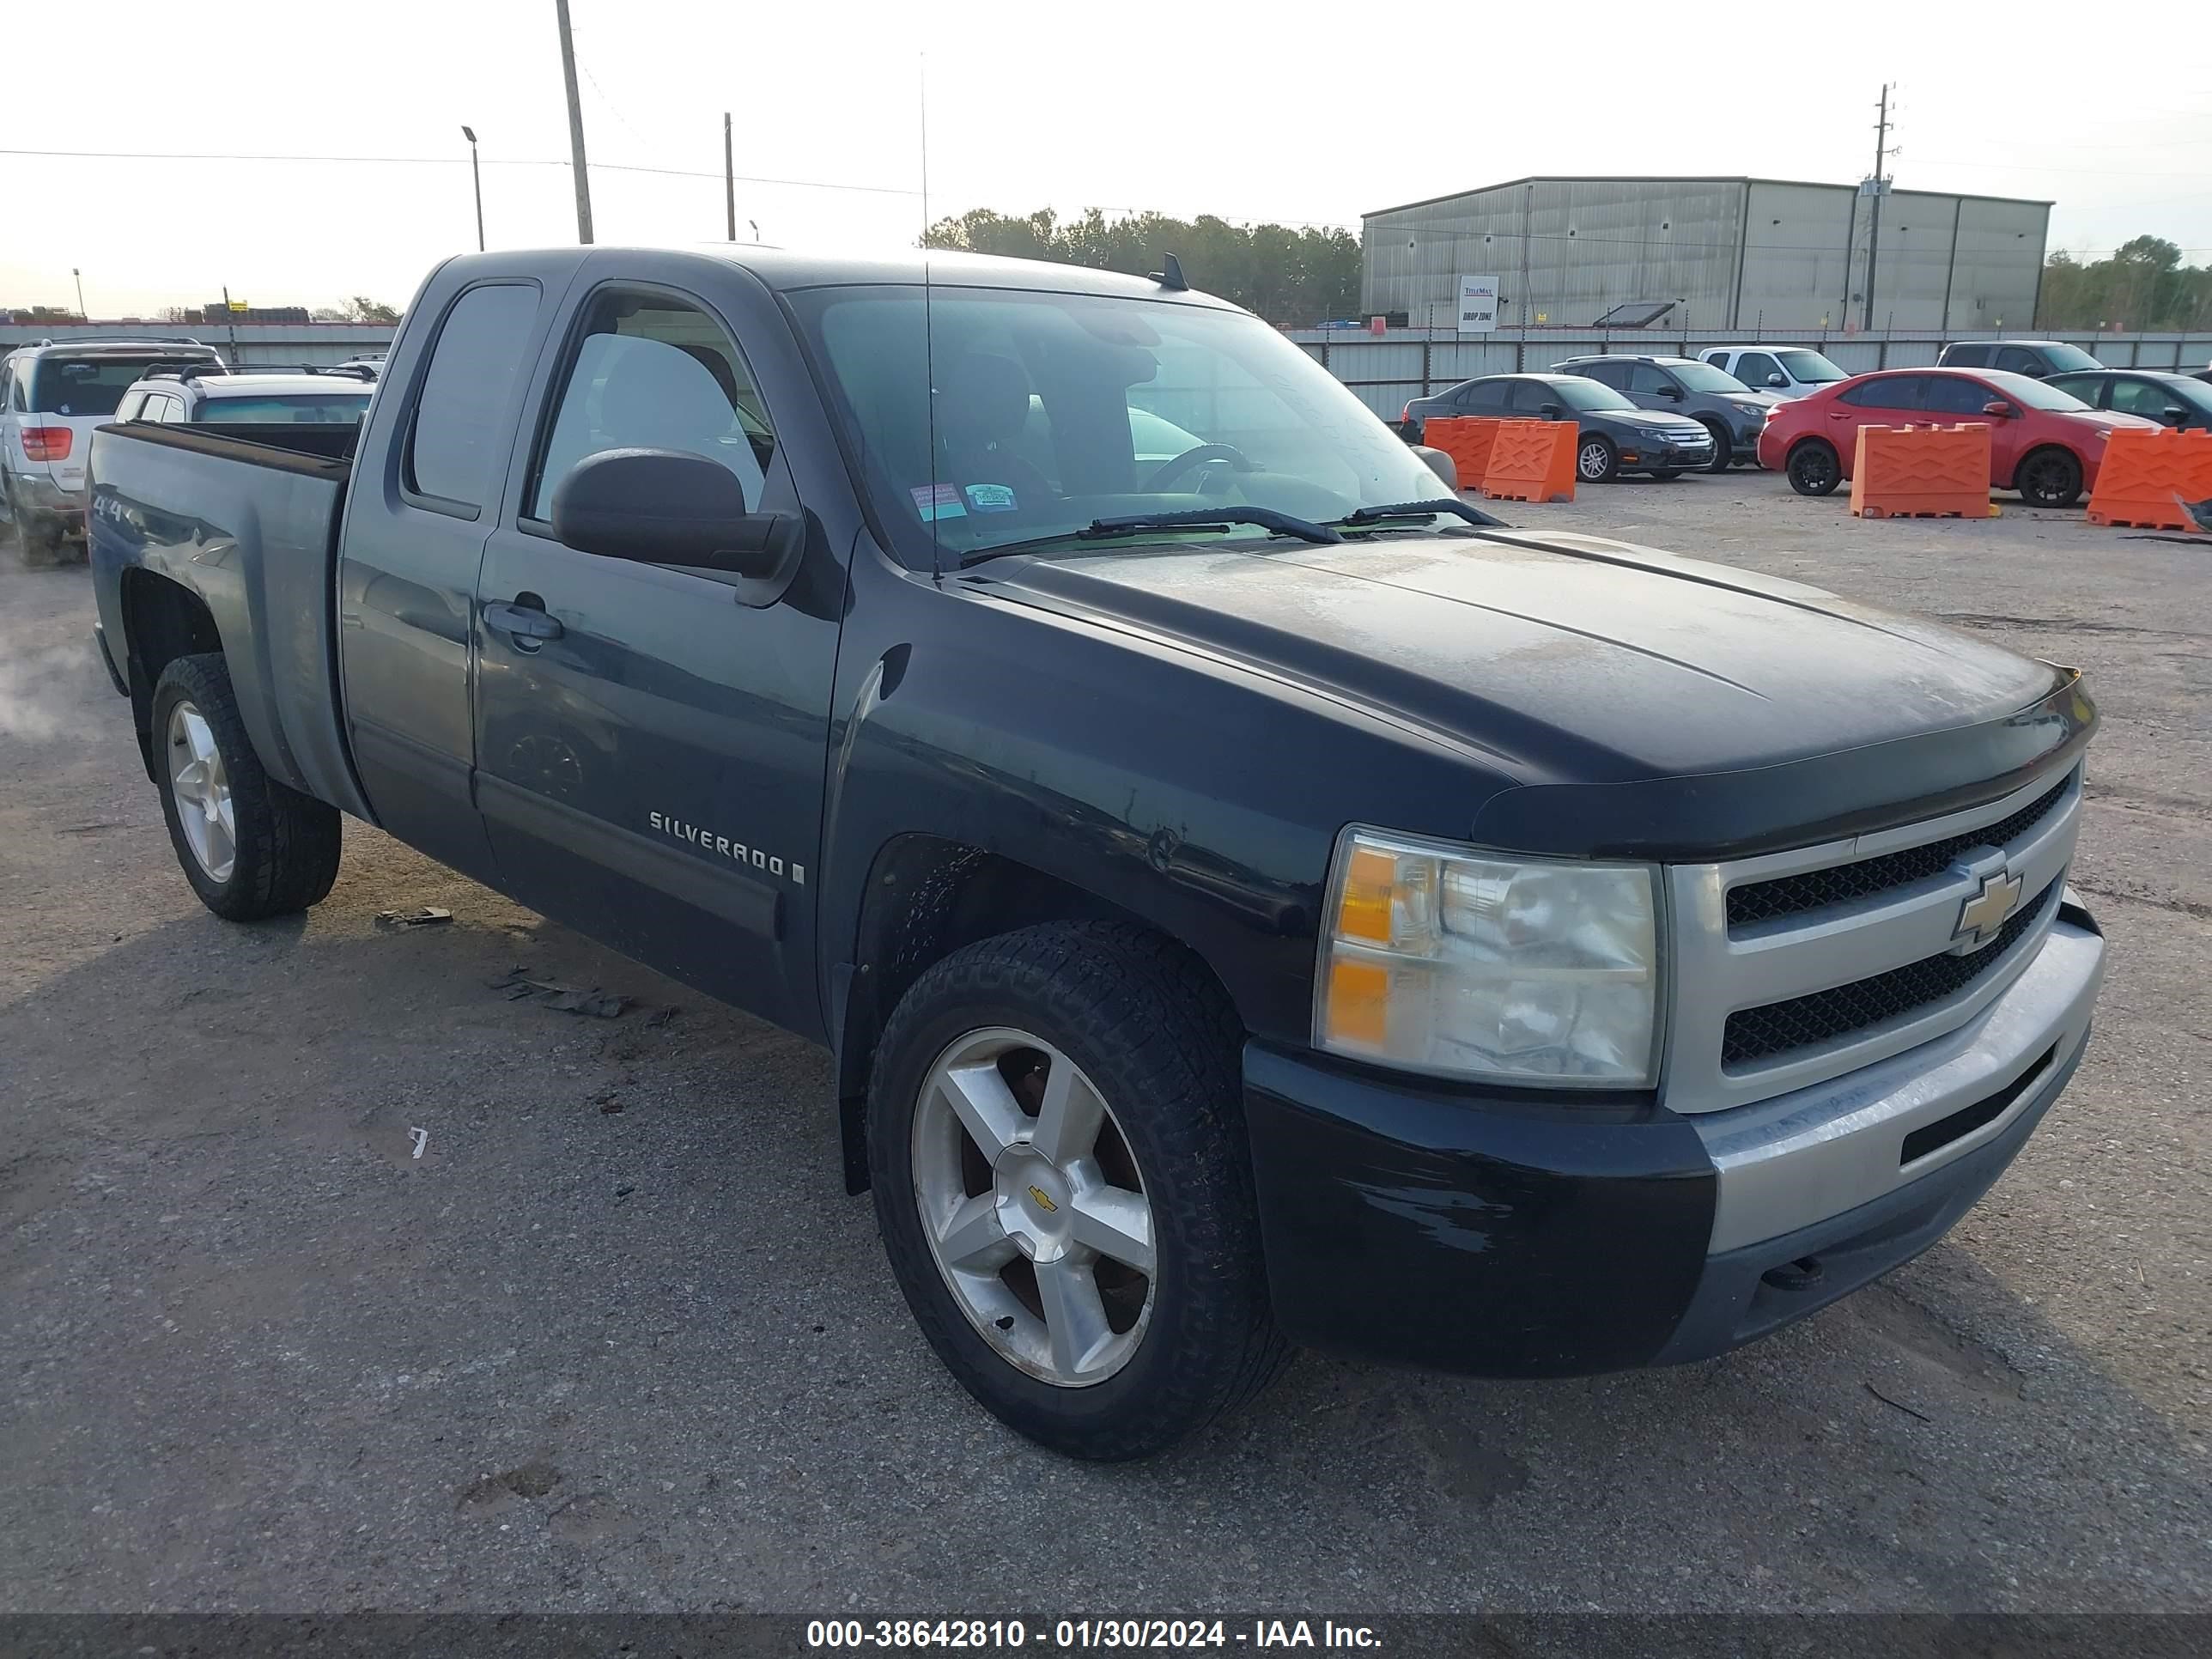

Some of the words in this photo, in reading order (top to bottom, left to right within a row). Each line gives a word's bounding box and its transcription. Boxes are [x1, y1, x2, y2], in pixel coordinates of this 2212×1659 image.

[1462, 312, 1478, 321] DROP
[1478, 312, 1492, 321] ZONE
[649, 811, 784, 877] SILVERADO
